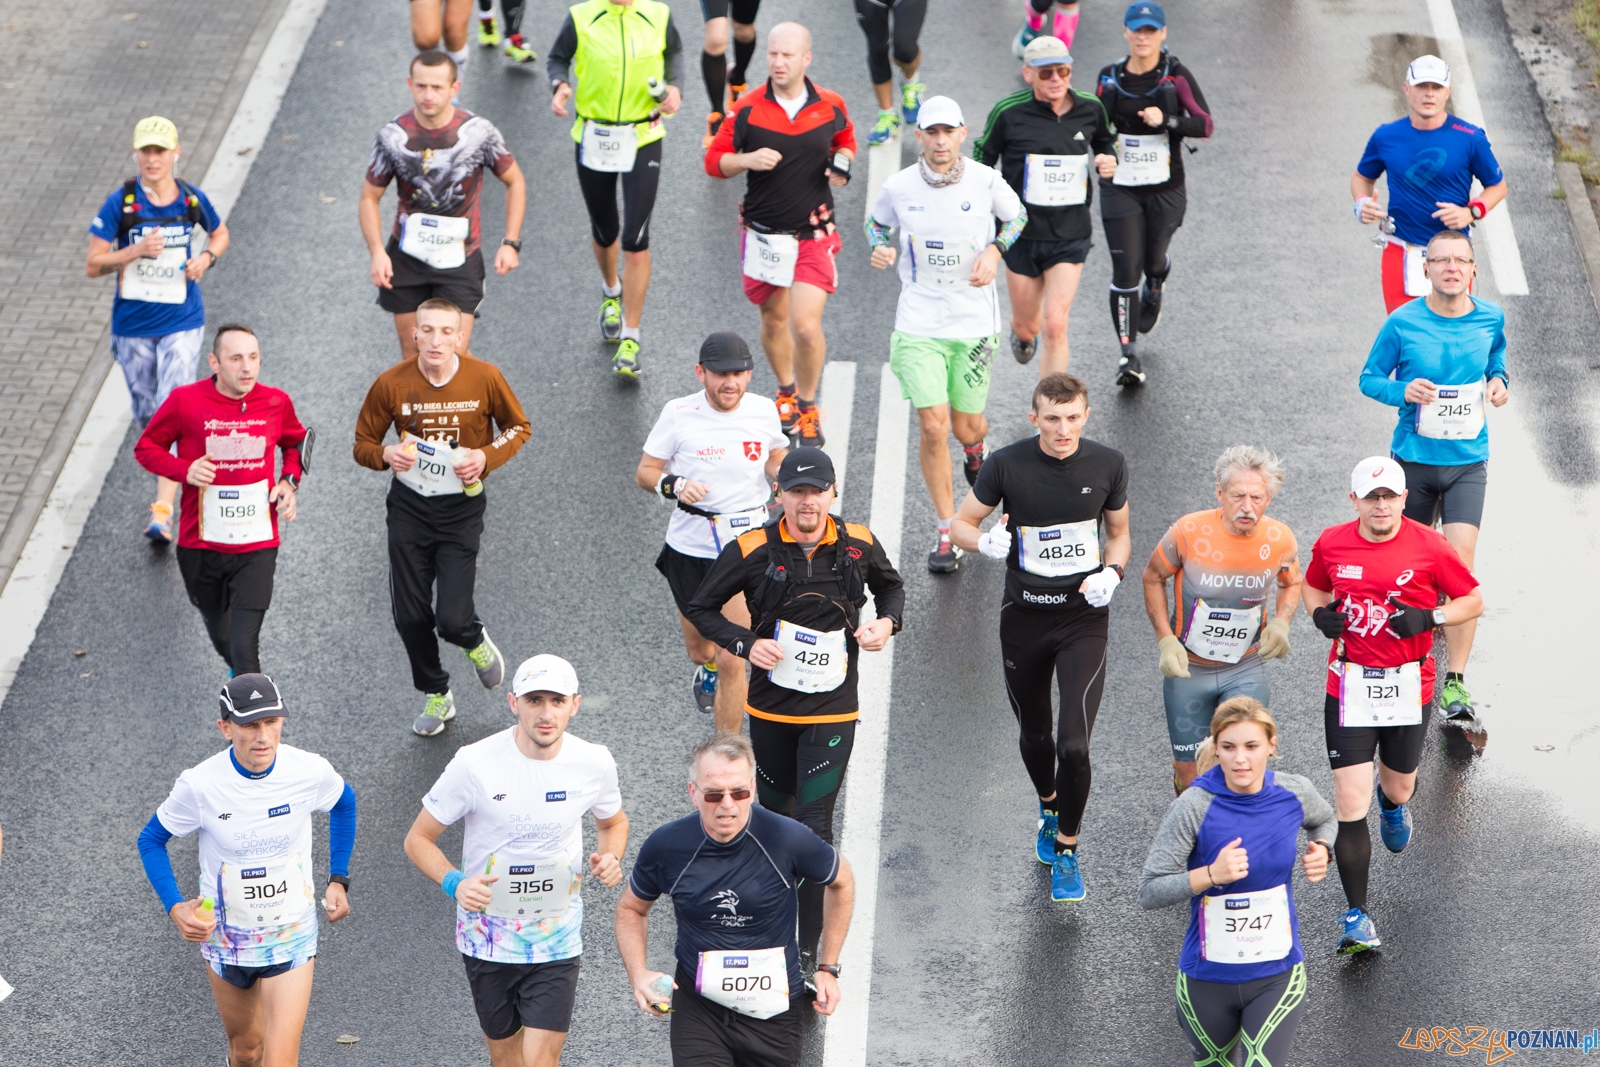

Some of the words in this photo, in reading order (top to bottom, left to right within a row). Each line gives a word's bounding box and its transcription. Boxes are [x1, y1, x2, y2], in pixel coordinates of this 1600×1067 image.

[598, 141, 620, 151] 150
[1124, 151, 1158, 163] 6548
[1043, 172, 1075, 183] 1847
[417, 232, 454, 245] 5462
[758, 246, 781, 263] 1616
[928, 254, 961, 267] 6561
[136, 264, 175, 278] 5000
[963, 359, 987, 388] PUMA
[413, 403, 423, 411] 39
[424, 402, 442, 410] BIEG
[443, 399, 480, 410] LECHITÓW
[1438, 403, 1472, 417] 2145
[696, 445, 726, 457] active
[417, 458, 446, 476] 1701
[218, 505, 256, 518] 1698
[1038, 543, 1086, 560] 4826
[1200, 573, 1244, 588] MOVE
[1245, 575, 1266, 589] ON
[1023, 590, 1068, 605] Reebok
[1202, 624, 1248, 640] 2946
[1206, 638, 1239, 647] Eugeniusz
[795, 650, 830, 666] 428
[1366, 685, 1400, 700] 1321
[1173, 743, 1195, 752] MOVE
[492, 793, 507, 801] 4F
[218, 812, 232, 821] 4F
[509, 814, 531, 823] SIŁA
[516, 823, 562, 832] ODWAGA
[233, 831, 258, 841] SIŁA
[242, 835, 290, 849] ODWAGA
[508, 831, 561, 840] SZYBKOŚĆ
[235, 843, 289, 857] SZYBKOŚĆ
[244, 880, 288, 900] 3104
[509, 878, 554, 894] 3156
[250, 898, 285, 910] Krzysztof
[519, 895, 543, 903] Daniel
[1225, 914, 1274, 933] 3747
[1236, 936, 1263, 944] Magda
[721, 975, 772, 992] 6070
